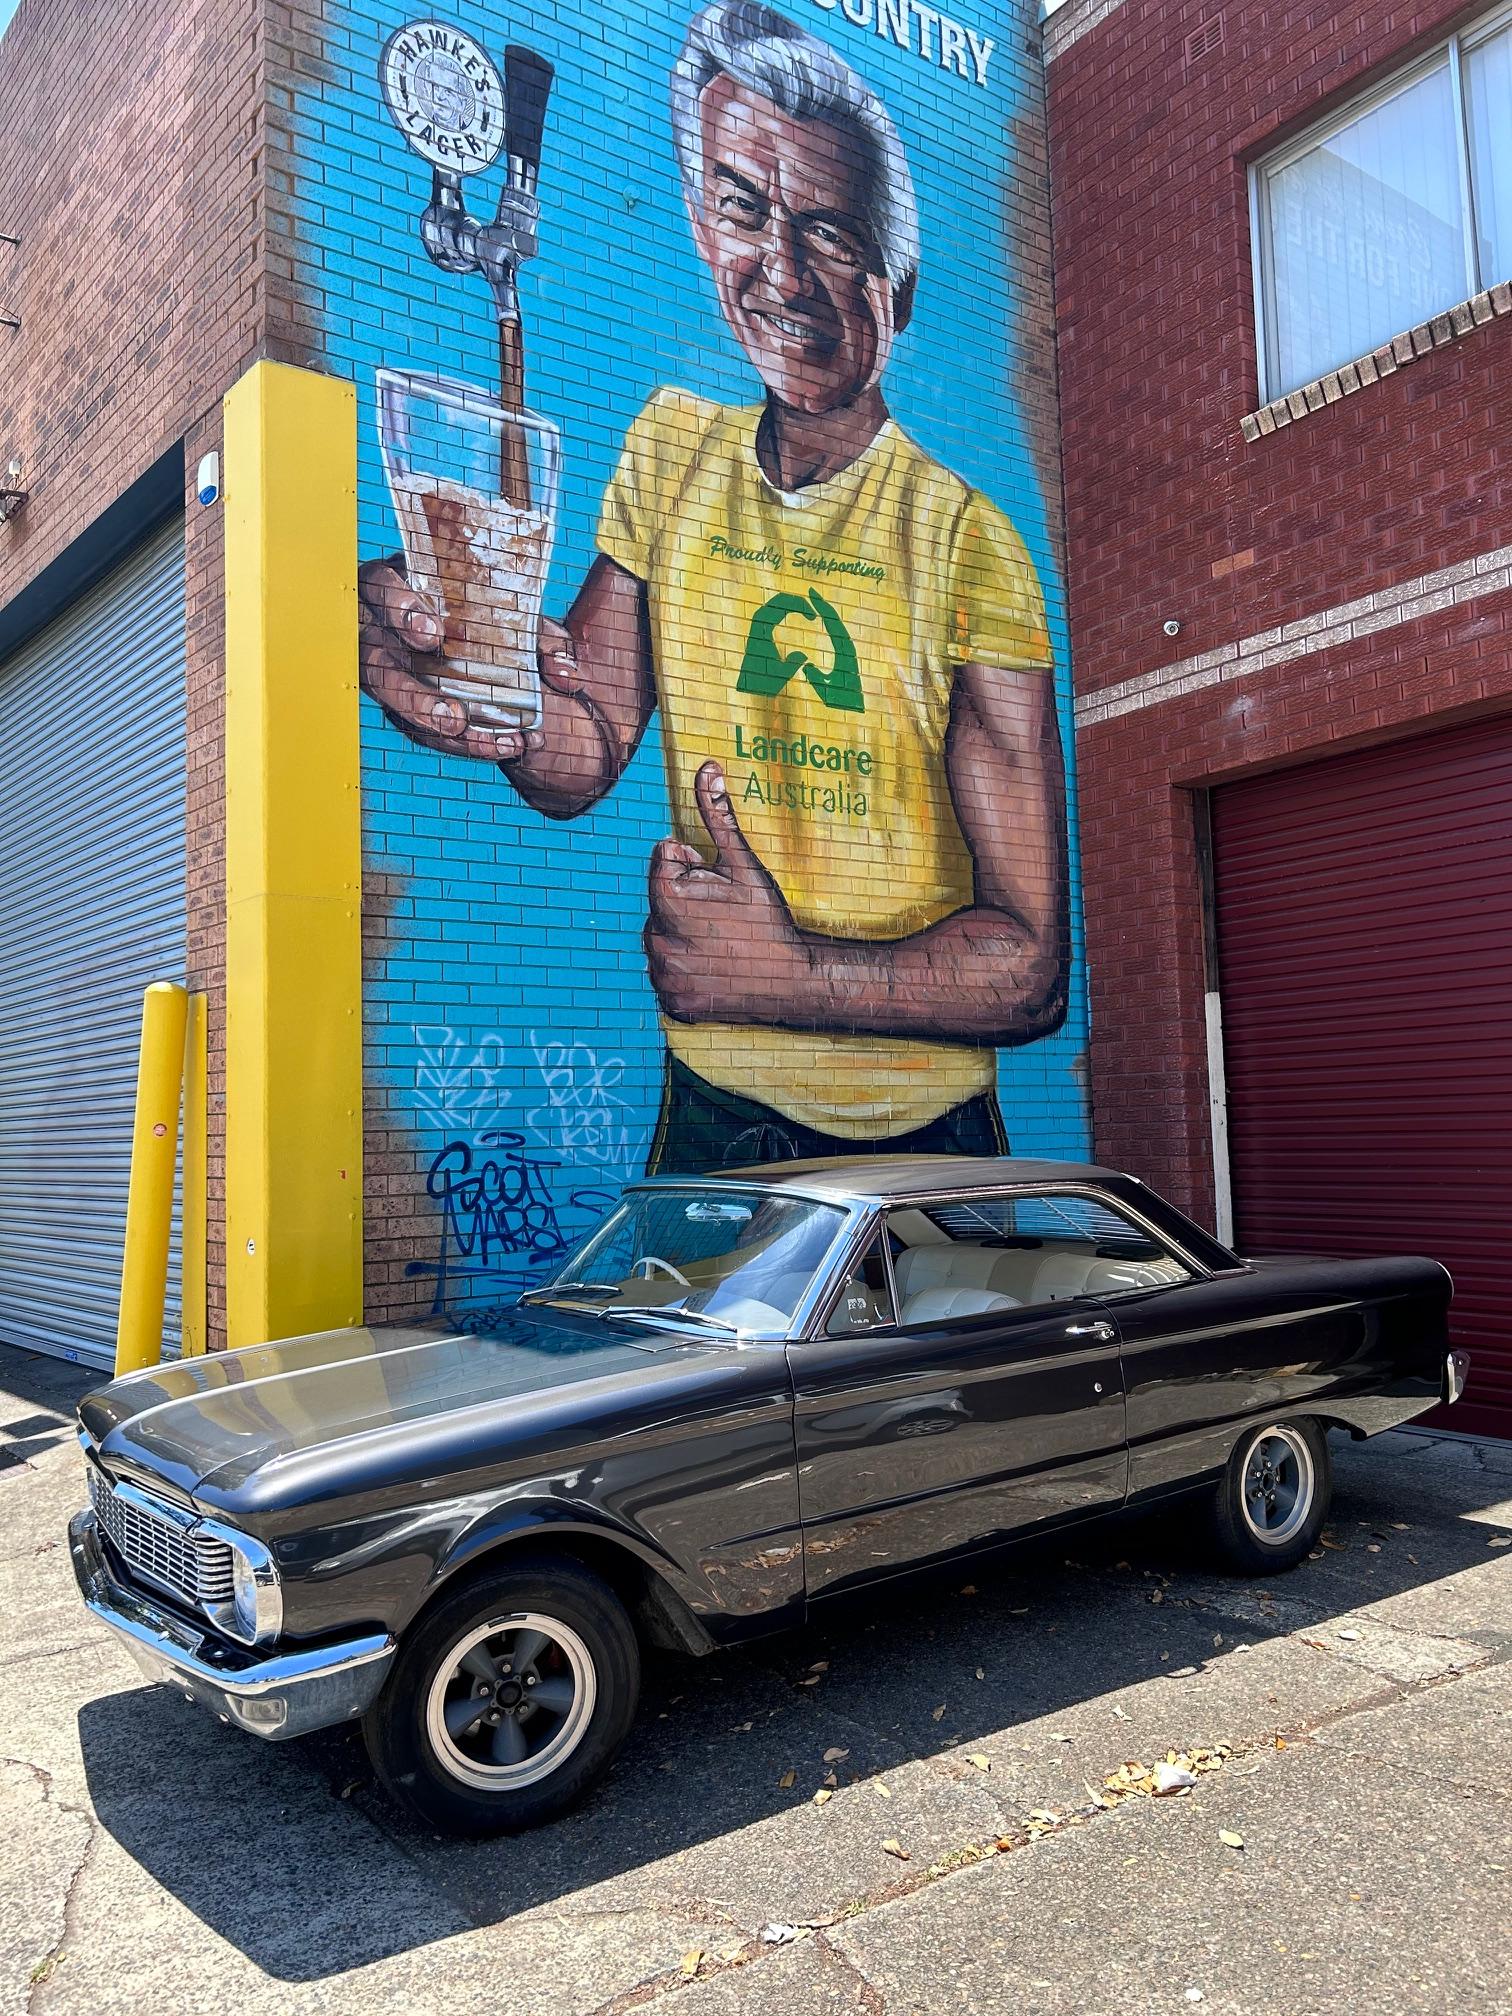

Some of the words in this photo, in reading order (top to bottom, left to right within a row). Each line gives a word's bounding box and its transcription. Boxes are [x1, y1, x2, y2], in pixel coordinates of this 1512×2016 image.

[808, 0, 995, 88] UNTRY
[406, 110, 482, 158] LAGER
[709, 535, 784, 570] Proudly
[791, 548, 887, 582] Supporting
[735, 725, 873, 776] Landcare
[743, 771, 868, 817] Australia
